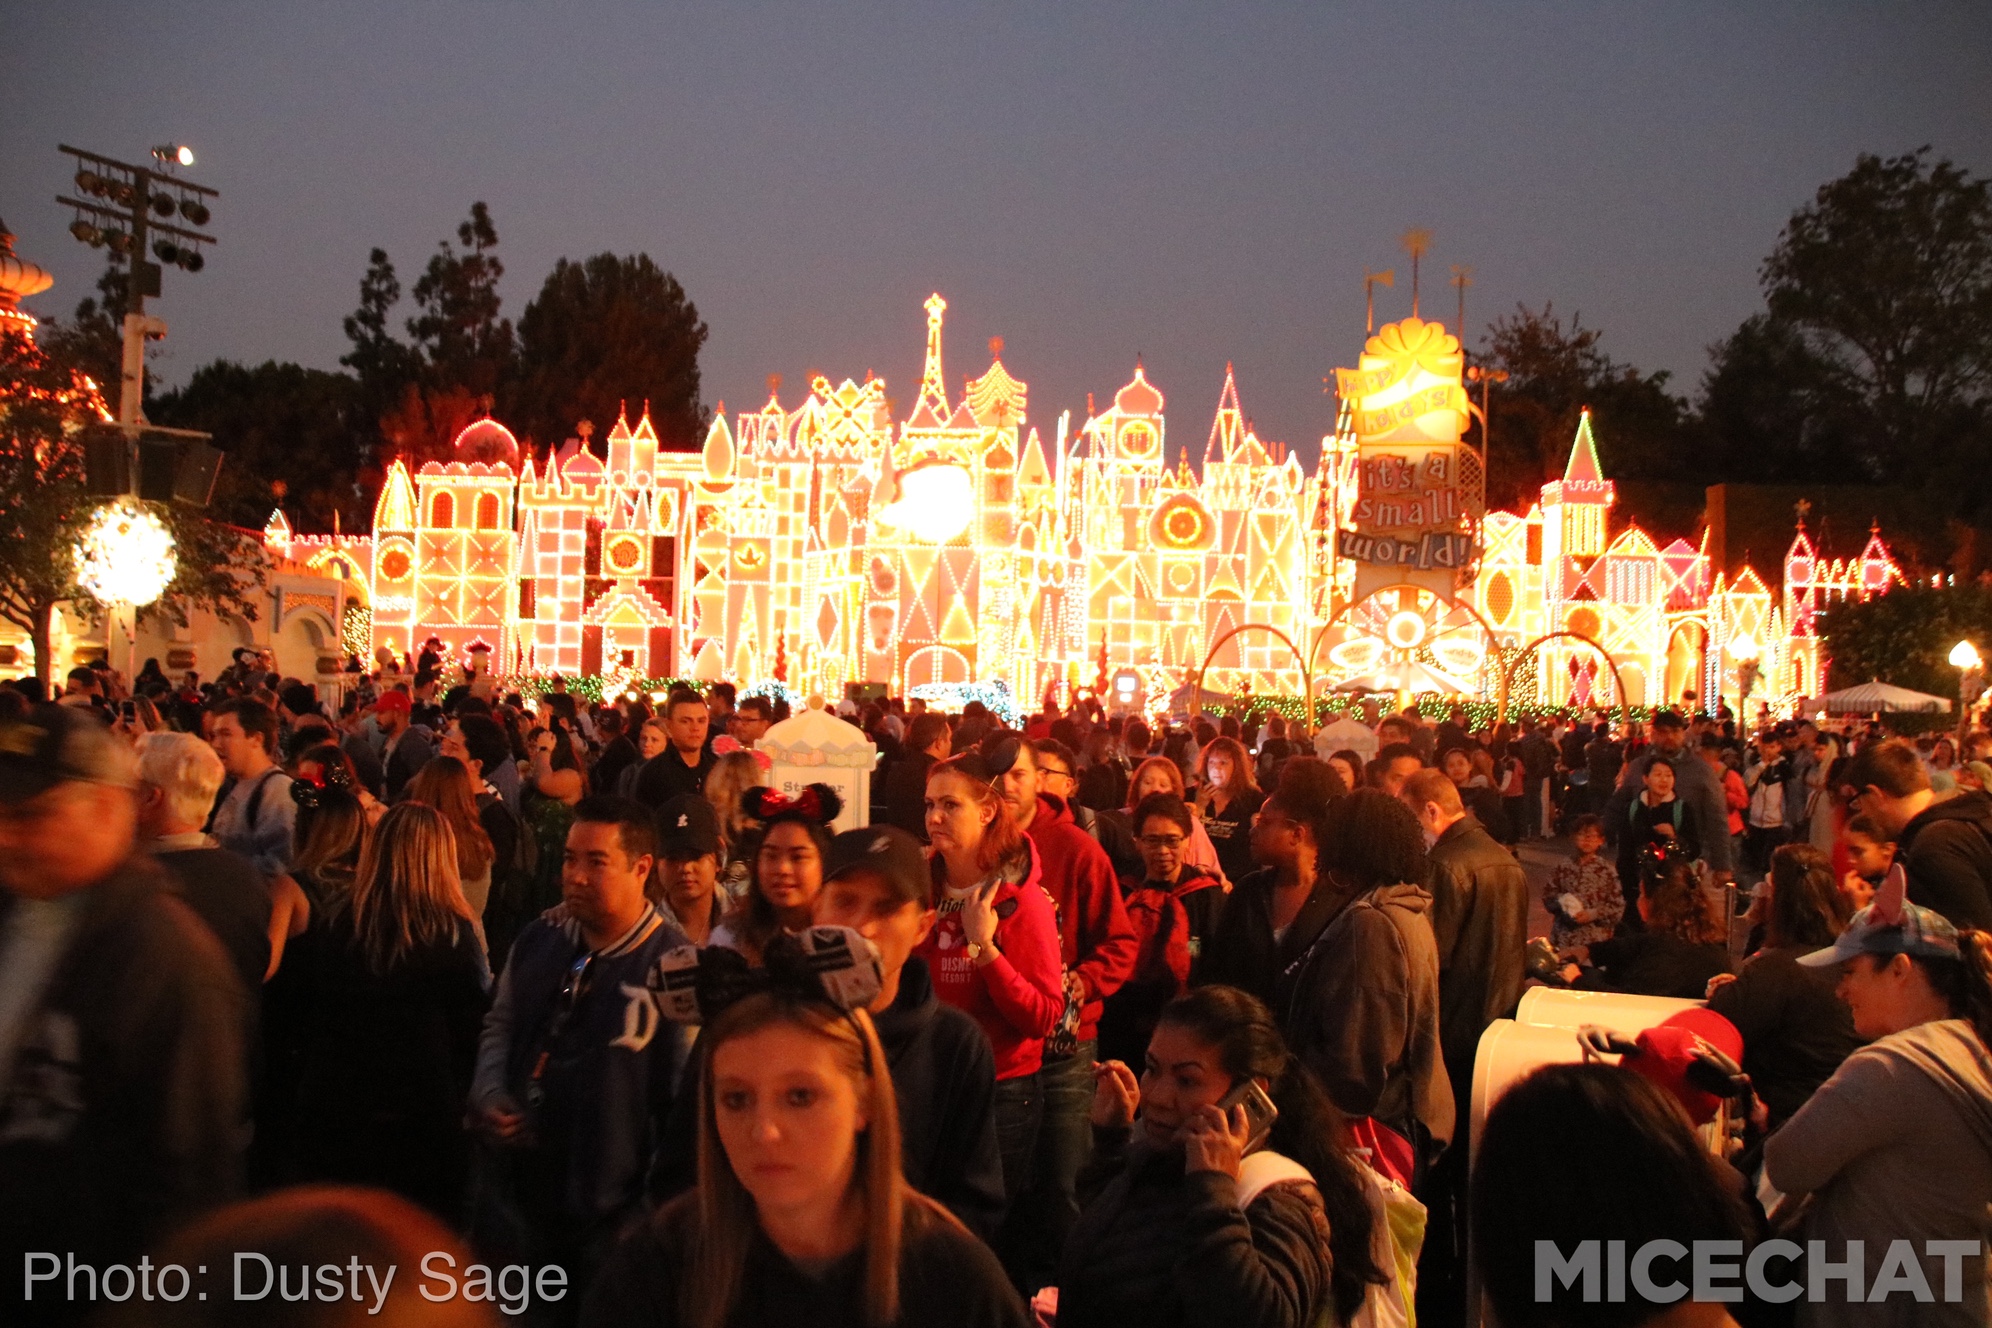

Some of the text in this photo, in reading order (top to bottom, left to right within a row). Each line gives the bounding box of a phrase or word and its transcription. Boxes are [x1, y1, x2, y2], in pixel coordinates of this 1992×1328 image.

[1341, 363, 1397, 395] hppy
[1364, 386, 1455, 432] holidys!
[1367, 456, 1447, 489] it's a
[1357, 489, 1459, 528] small
[1342, 532, 1468, 569] world!
